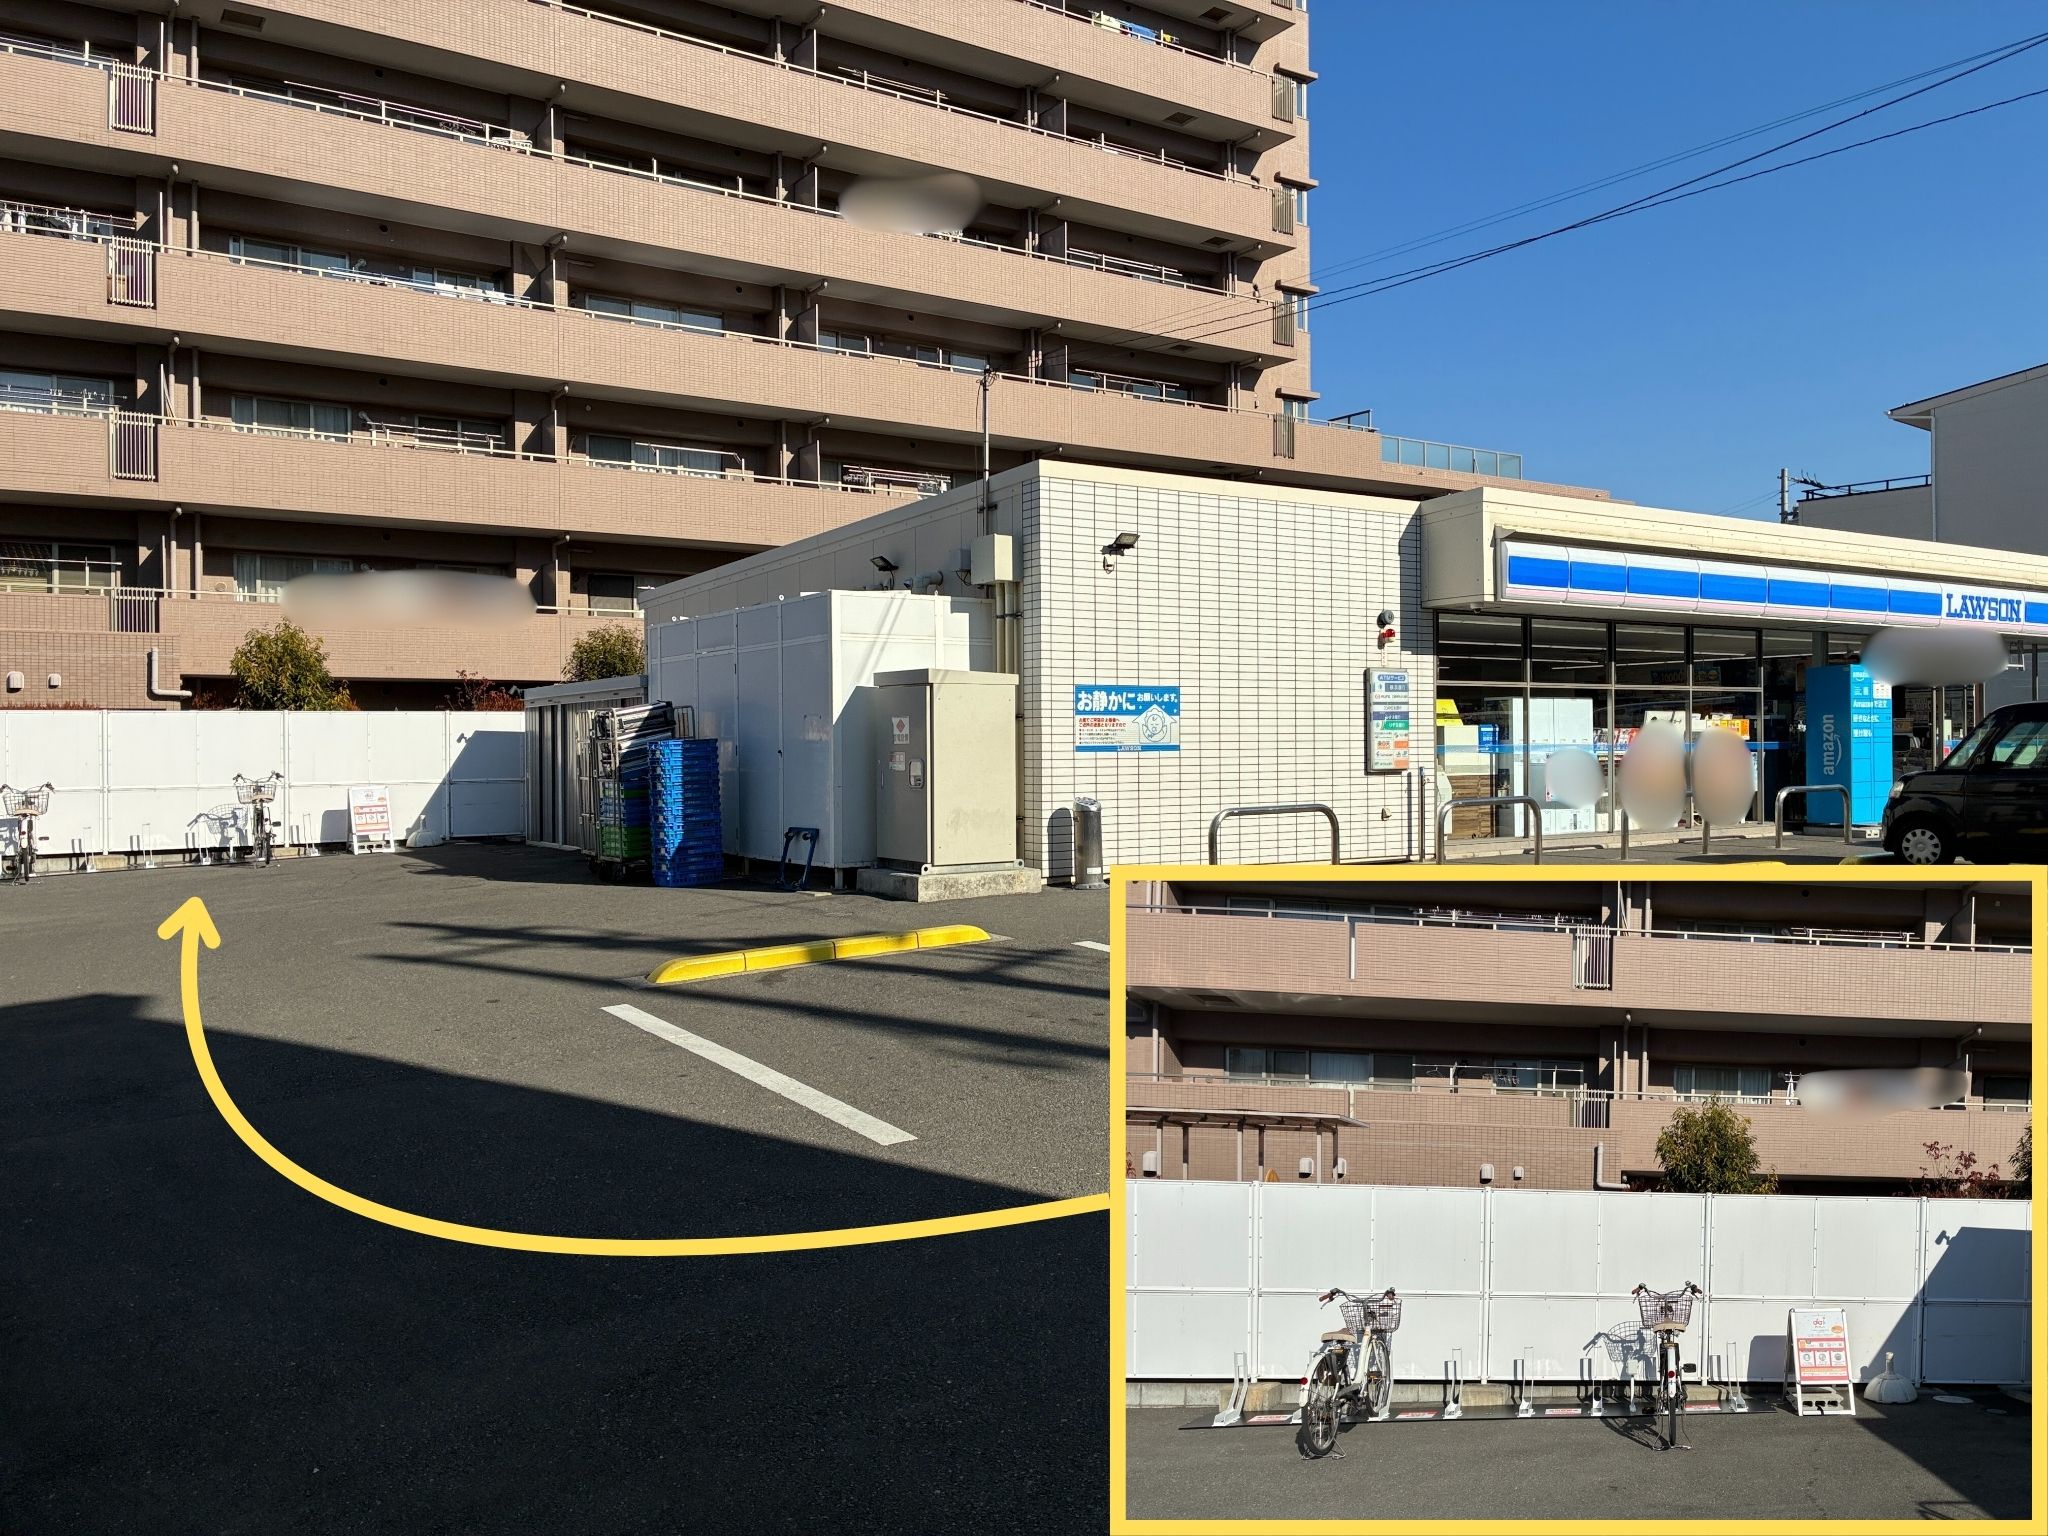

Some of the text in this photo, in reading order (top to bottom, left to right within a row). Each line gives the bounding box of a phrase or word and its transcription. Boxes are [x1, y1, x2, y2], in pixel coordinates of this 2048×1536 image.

[1946, 593, 2021, 622] LAWSON
[1077, 690, 1178, 711] お静かに お願いします。
[1823, 714, 1834, 776] amazon
